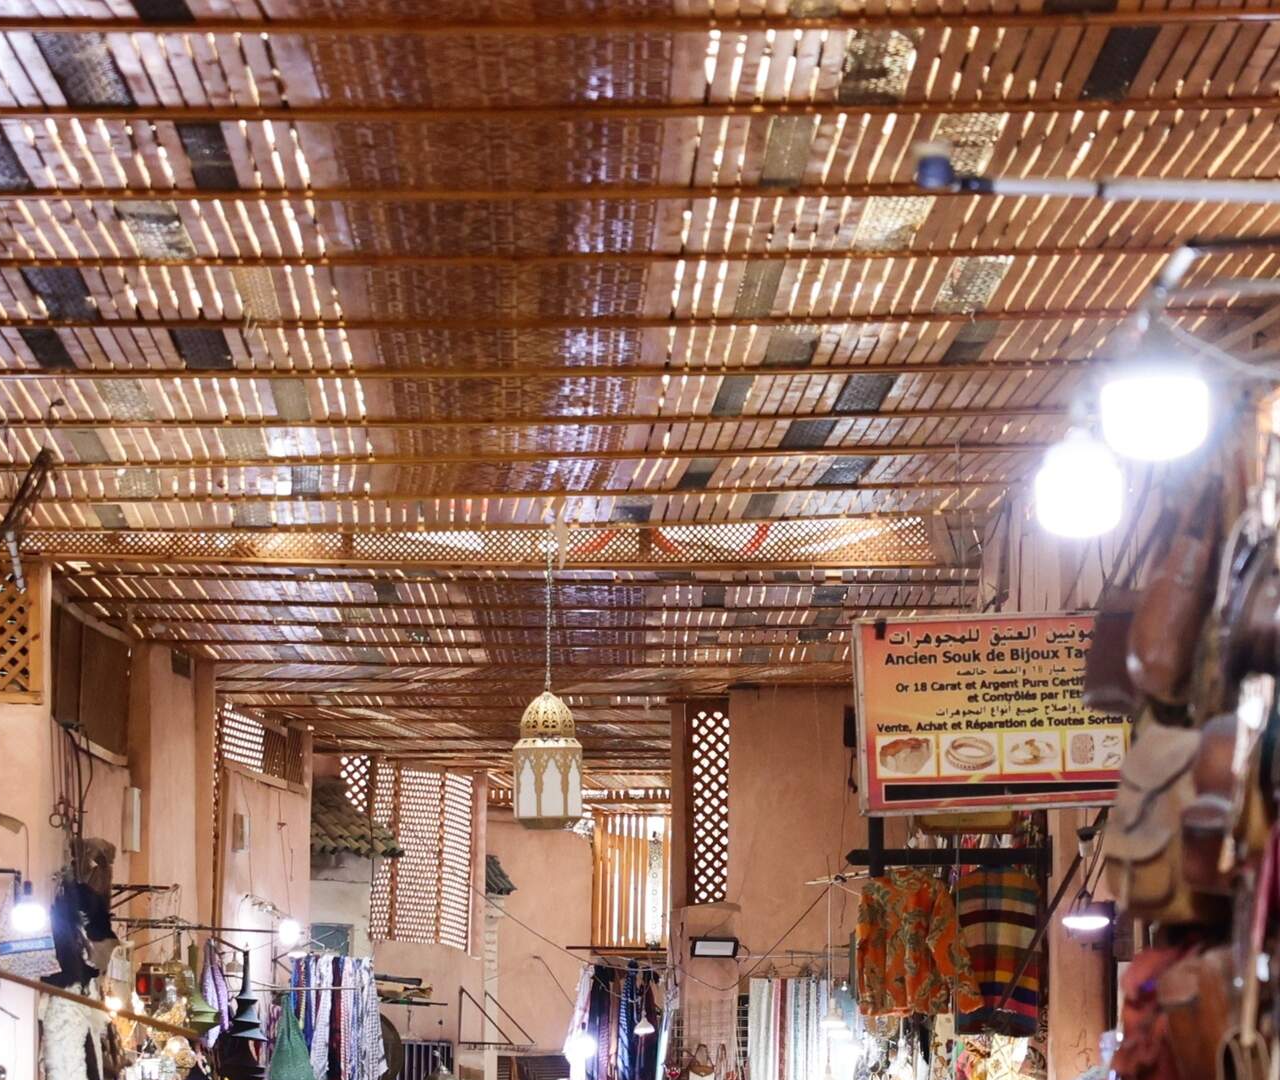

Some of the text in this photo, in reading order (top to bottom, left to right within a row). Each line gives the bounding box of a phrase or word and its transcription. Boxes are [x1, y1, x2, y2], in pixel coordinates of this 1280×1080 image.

[889, 628, 980, 648] للمجوهرات
[885, 652, 937, 665] Ancien
[942, 649, 981, 664] Souk
[986, 648, 1006, 661] de
[1010, 647, 1060, 663] Bijoux
[896, 682, 910, 693] Or
[914, 681, 927, 692] 18
[931, 680, 962, 692] Carat
[965, 681, 976, 690] et
[980, 679, 1018, 691] Argent
[1022, 678, 1049, 689] Pure
[967, 693, 979, 703] et
[1040, 690, 1060, 702] par
[877, 722, 912, 733] Vente,
[916, 720, 948, 732] Achat
[951, 720, 962, 730] et
[966, 718, 1027, 732] Réparation
[1030, 716, 1044, 727] de
[1047, 715, 1085, 728] Toutes
[1087, 713, 1124, 726] Sortes
